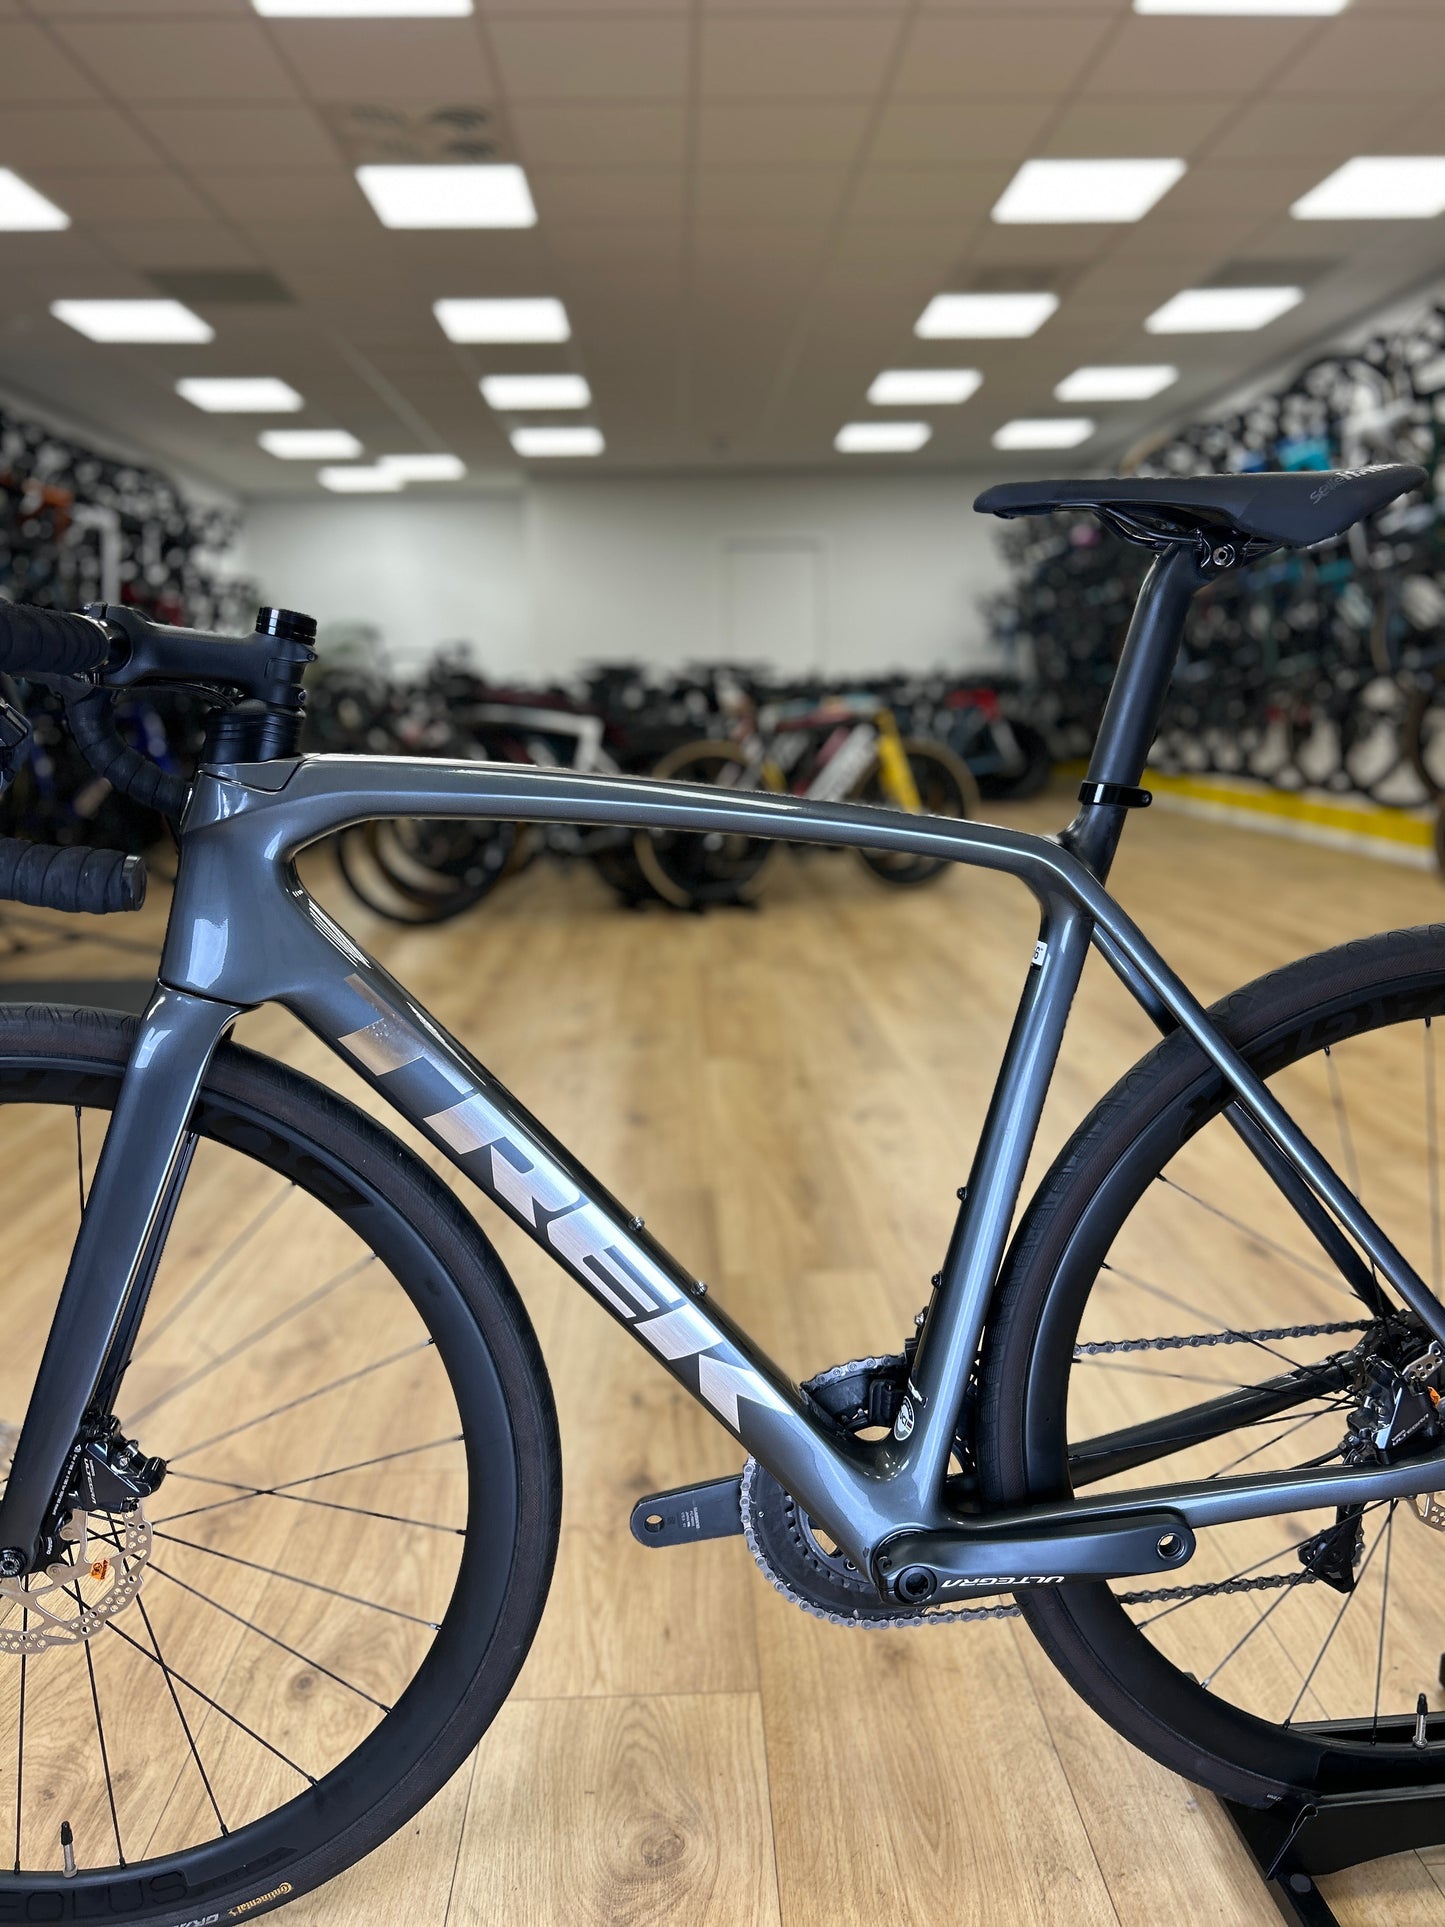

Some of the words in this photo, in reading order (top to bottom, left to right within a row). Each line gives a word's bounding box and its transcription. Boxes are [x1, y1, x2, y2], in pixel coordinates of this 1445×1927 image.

[337, 972, 795, 1434] TREK
[940, 1575, 1066, 1588] ULTEGRA
[236, 1881, 293, 1915] Continental
[173, 1913, 219, 1927] GRA
